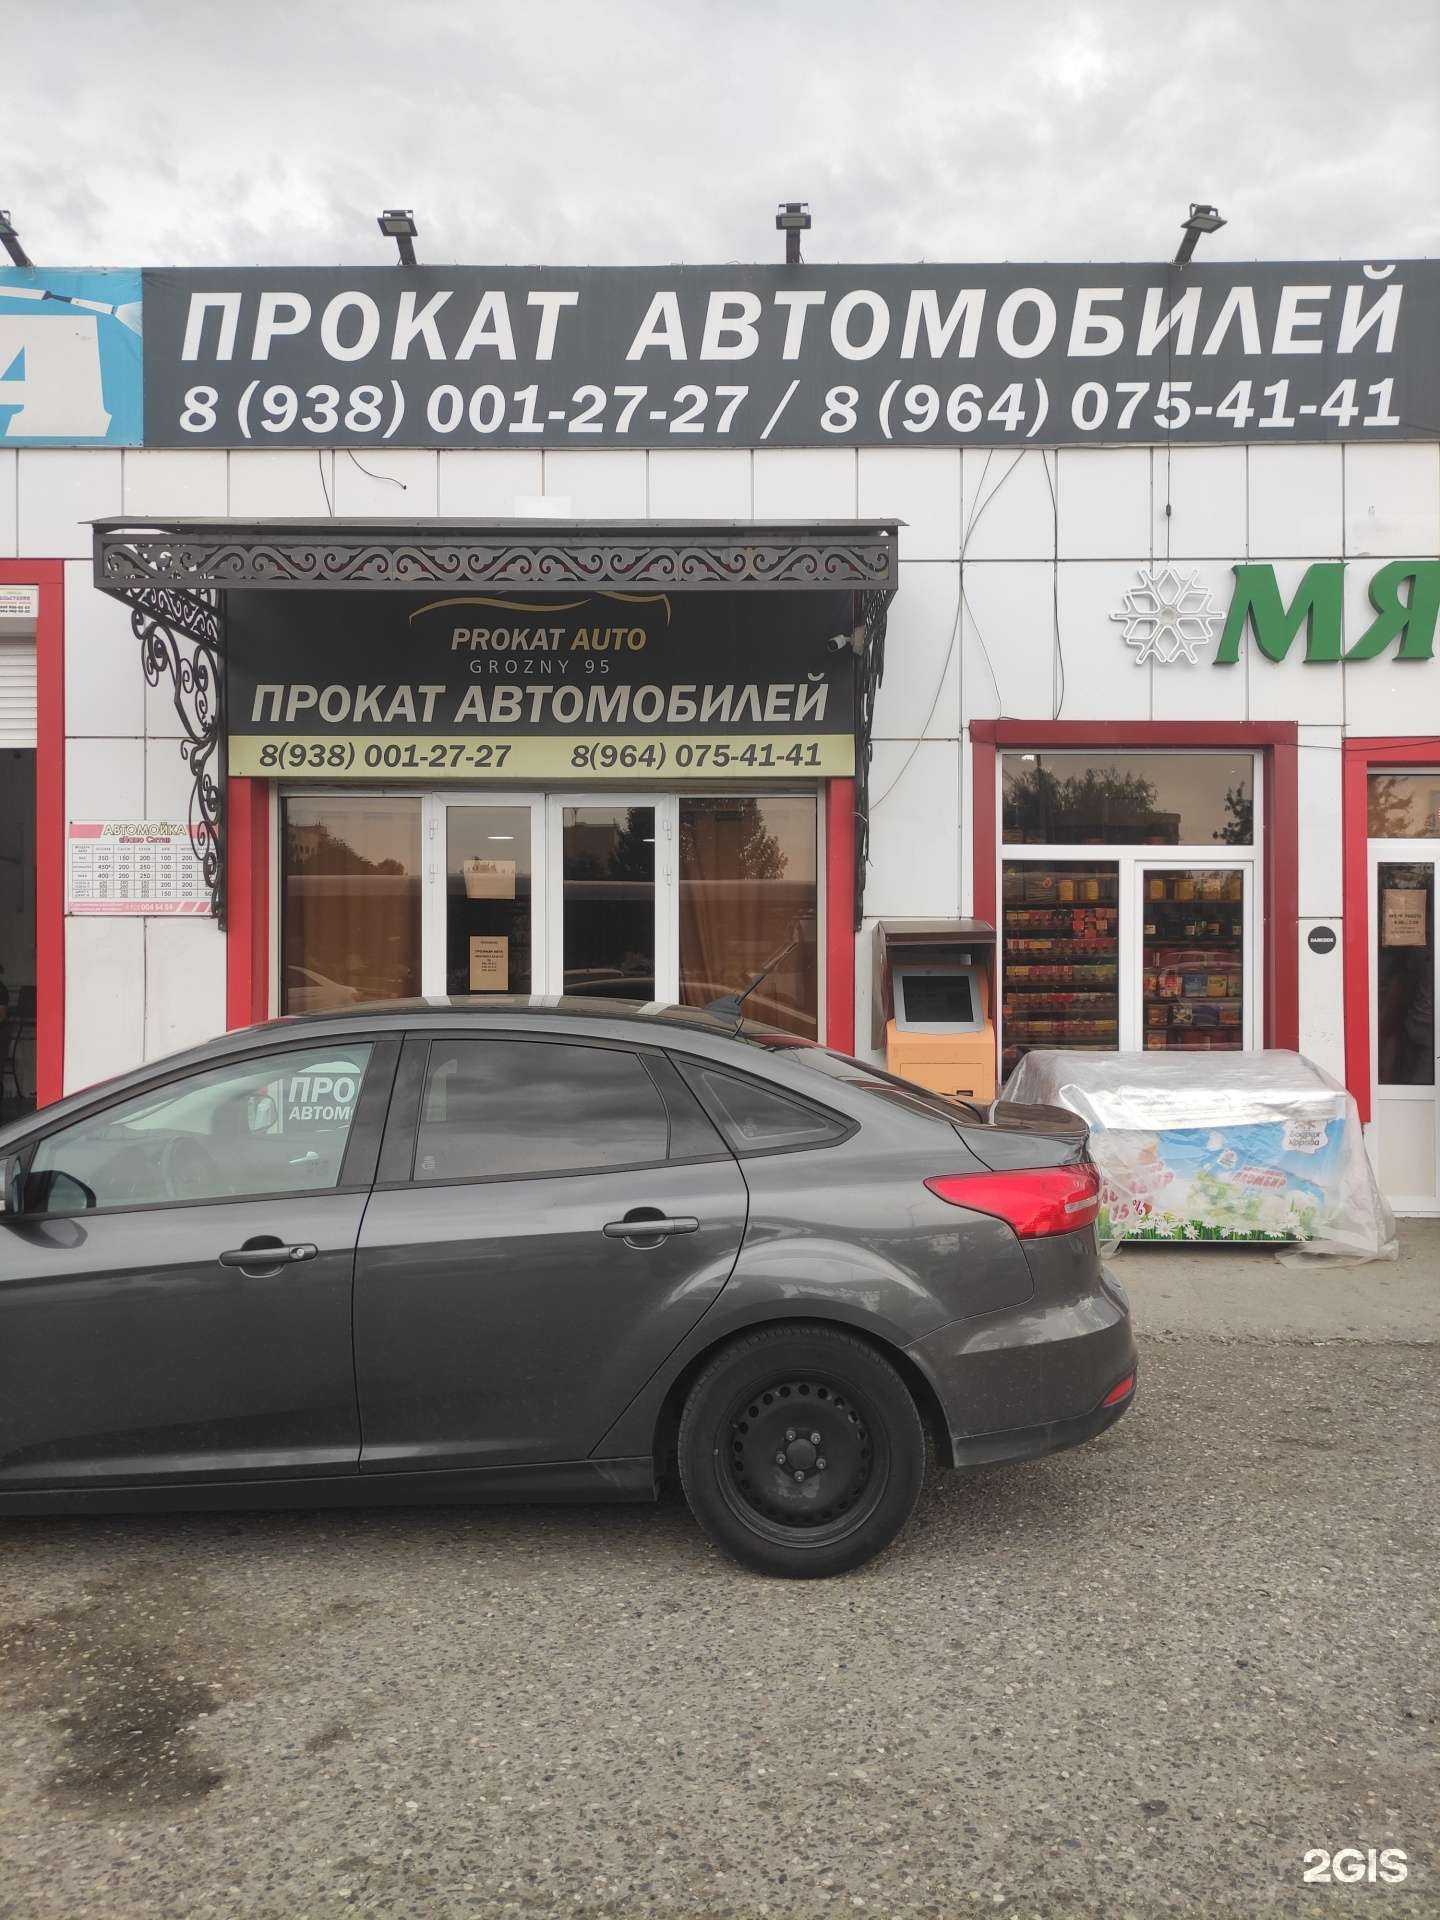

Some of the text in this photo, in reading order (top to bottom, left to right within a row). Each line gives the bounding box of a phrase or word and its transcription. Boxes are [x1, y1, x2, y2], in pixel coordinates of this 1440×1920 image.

[182, 267, 1403, 362] ПРОКАТ АВТОМОБИЛЕЙ
[180, 385, 219, 434] 8
[237, 379, 405, 439] (938)
[426, 384, 749, 434] 001-27-27
[820, 385, 860, 433] 8
[878, 377, 1050, 438] (964)
[1071, 377, 1401, 432] 075-41-41
[451, 628, 647, 651] PROKAT AUTO
[470, 659, 610, 674] GROZNY 95
[251, 672, 829, 723] ПРОКАТ АВТОМОБИЛЕЙ
[259, 741, 513, 770] 8(938) 001-27-27
[570, 742, 823, 771] 8(964) 075-41-41
[103, 822, 187, 836] АВТОМОЙКА
[288, 1077, 356, 1103] ПРО
[288, 1106, 353, 1121] АВТОМ
